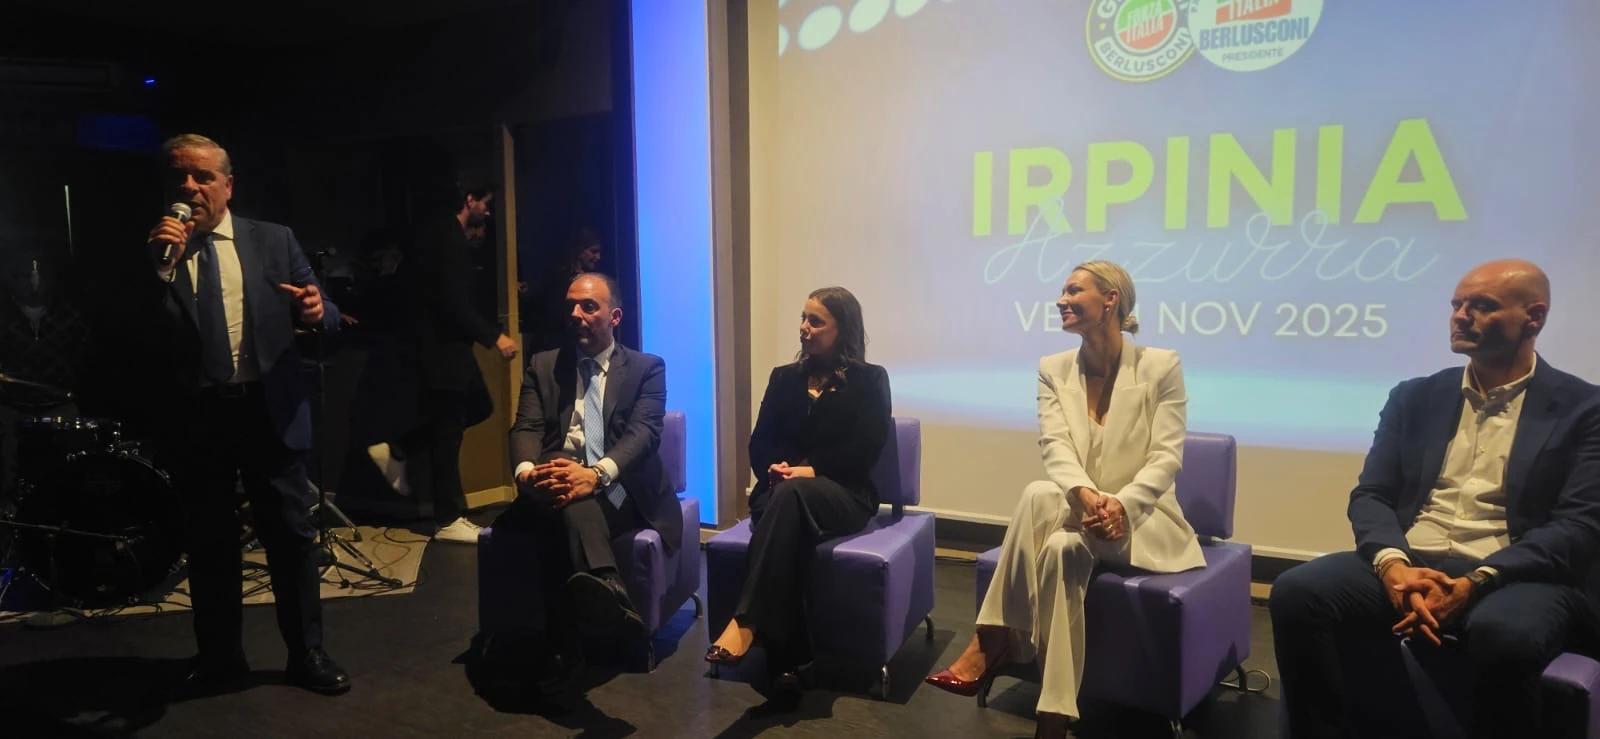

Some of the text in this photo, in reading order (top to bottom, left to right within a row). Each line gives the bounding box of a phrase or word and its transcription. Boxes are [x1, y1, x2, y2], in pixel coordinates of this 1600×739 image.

[1126, 15, 1164, 44] ITALIA
[1199, 16, 1310, 50] BERLUSCONI
[1100, 31, 1192, 74] BERLUSCONI
[1222, 47, 1285, 63] PRESIDENTE
[973, 117, 1469, 237] IRPINIA
[983, 195, 1442, 285] Azzurra
[1158, 300, 1263, 336] NOV
[1274, 303, 1390, 338] 2025
